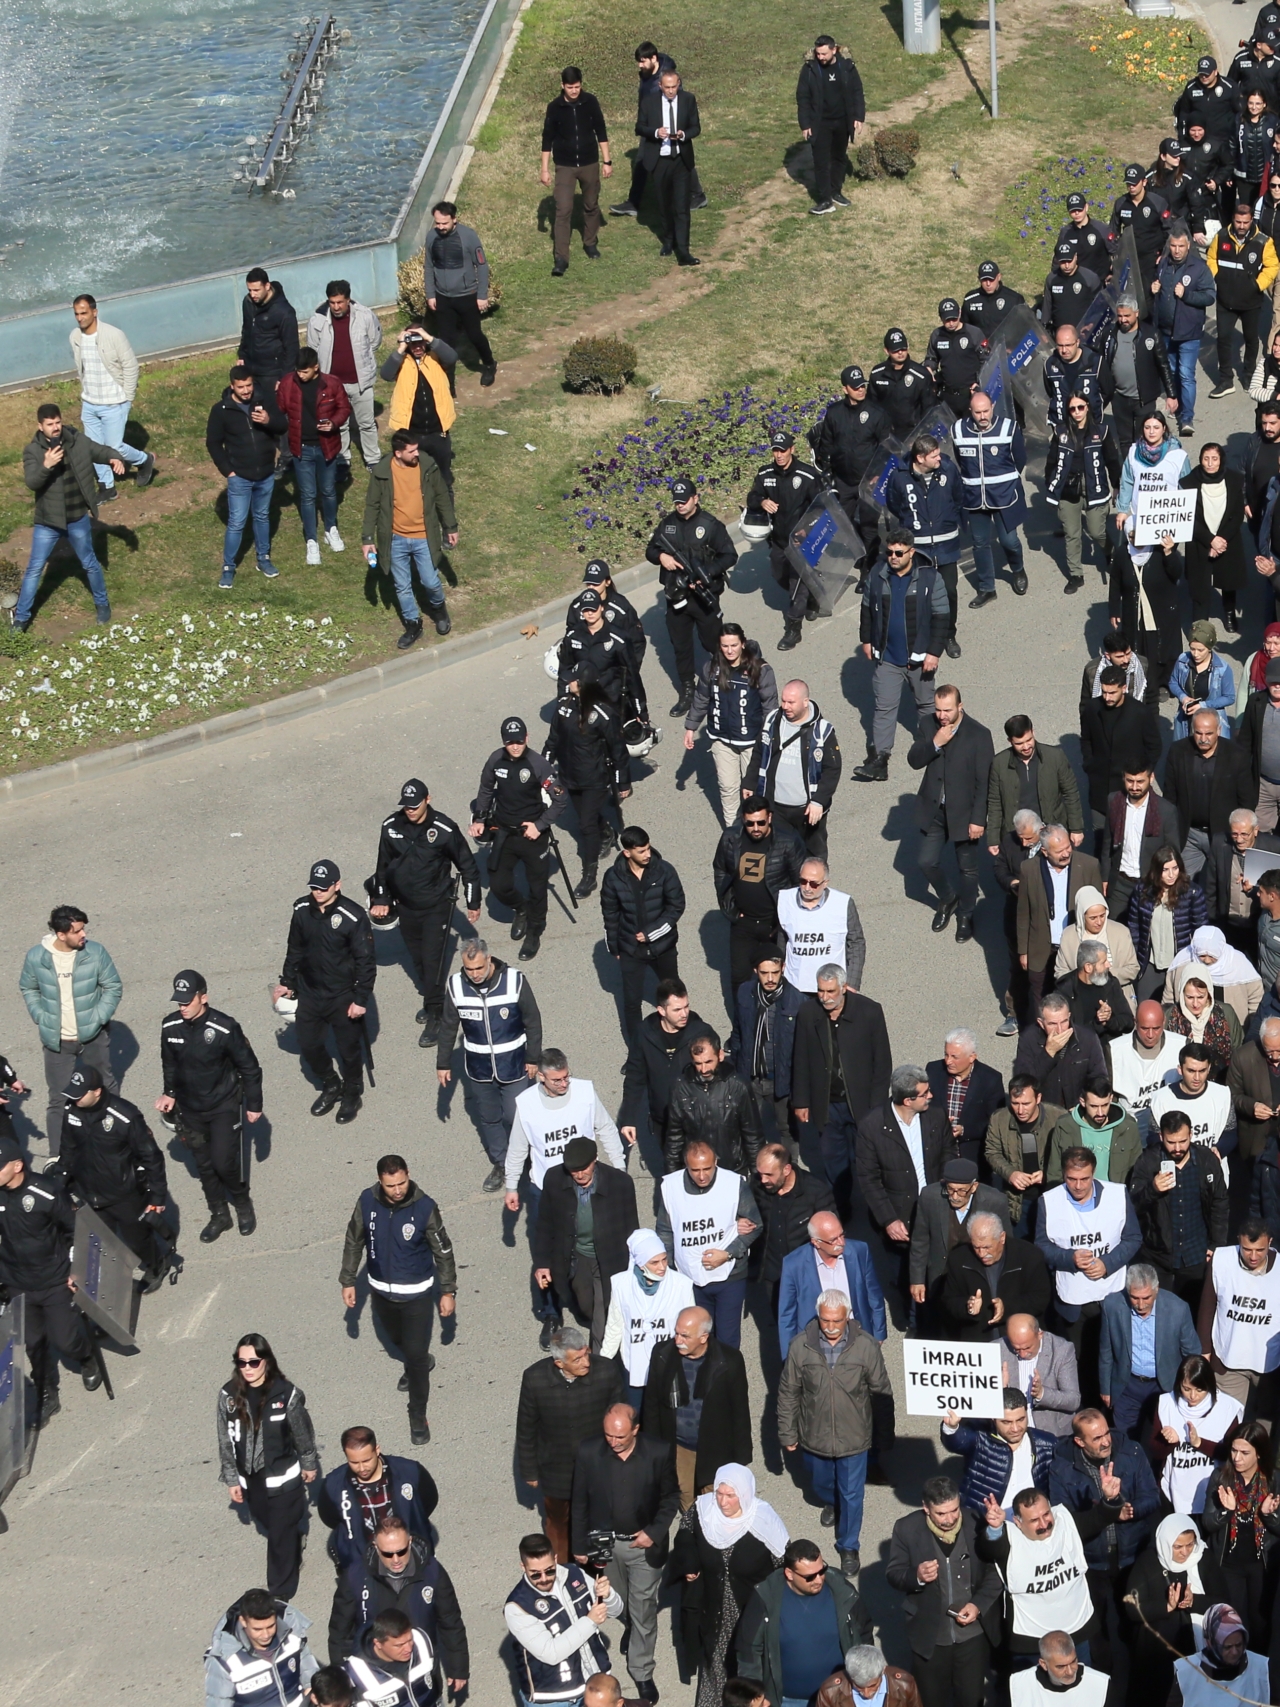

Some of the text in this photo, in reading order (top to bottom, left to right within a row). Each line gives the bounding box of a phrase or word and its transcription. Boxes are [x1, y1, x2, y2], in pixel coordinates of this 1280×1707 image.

[1010, 337, 1035, 368] POLİS
[1140, 472, 1164, 482] MEŞA
[1150, 496, 1186, 510] İMRALI
[1140, 510, 1193, 526] TECRİTİNE
[1154, 528, 1176, 540] SON
[740, 688, 748, 735] POLİS
[794, 932, 824, 945] MEŞA
[544, 1124, 578, 1144] MEŞA
[682, 1217, 715, 1234] MEŞA
[681, 1230, 724, 1248] AZADIYÊ
[1070, 1232, 1102, 1247] MEŞA
[1232, 1294, 1266, 1312] MEŞA
[1226, 1310, 1272, 1325] AZADIYÊ
[922, 1347, 982, 1367] İMRALI
[909, 1370, 998, 1390] TECRİTİNE
[937, 1395, 973, 1410] SON
[1035, 1556, 1066, 1577] MEŞA
